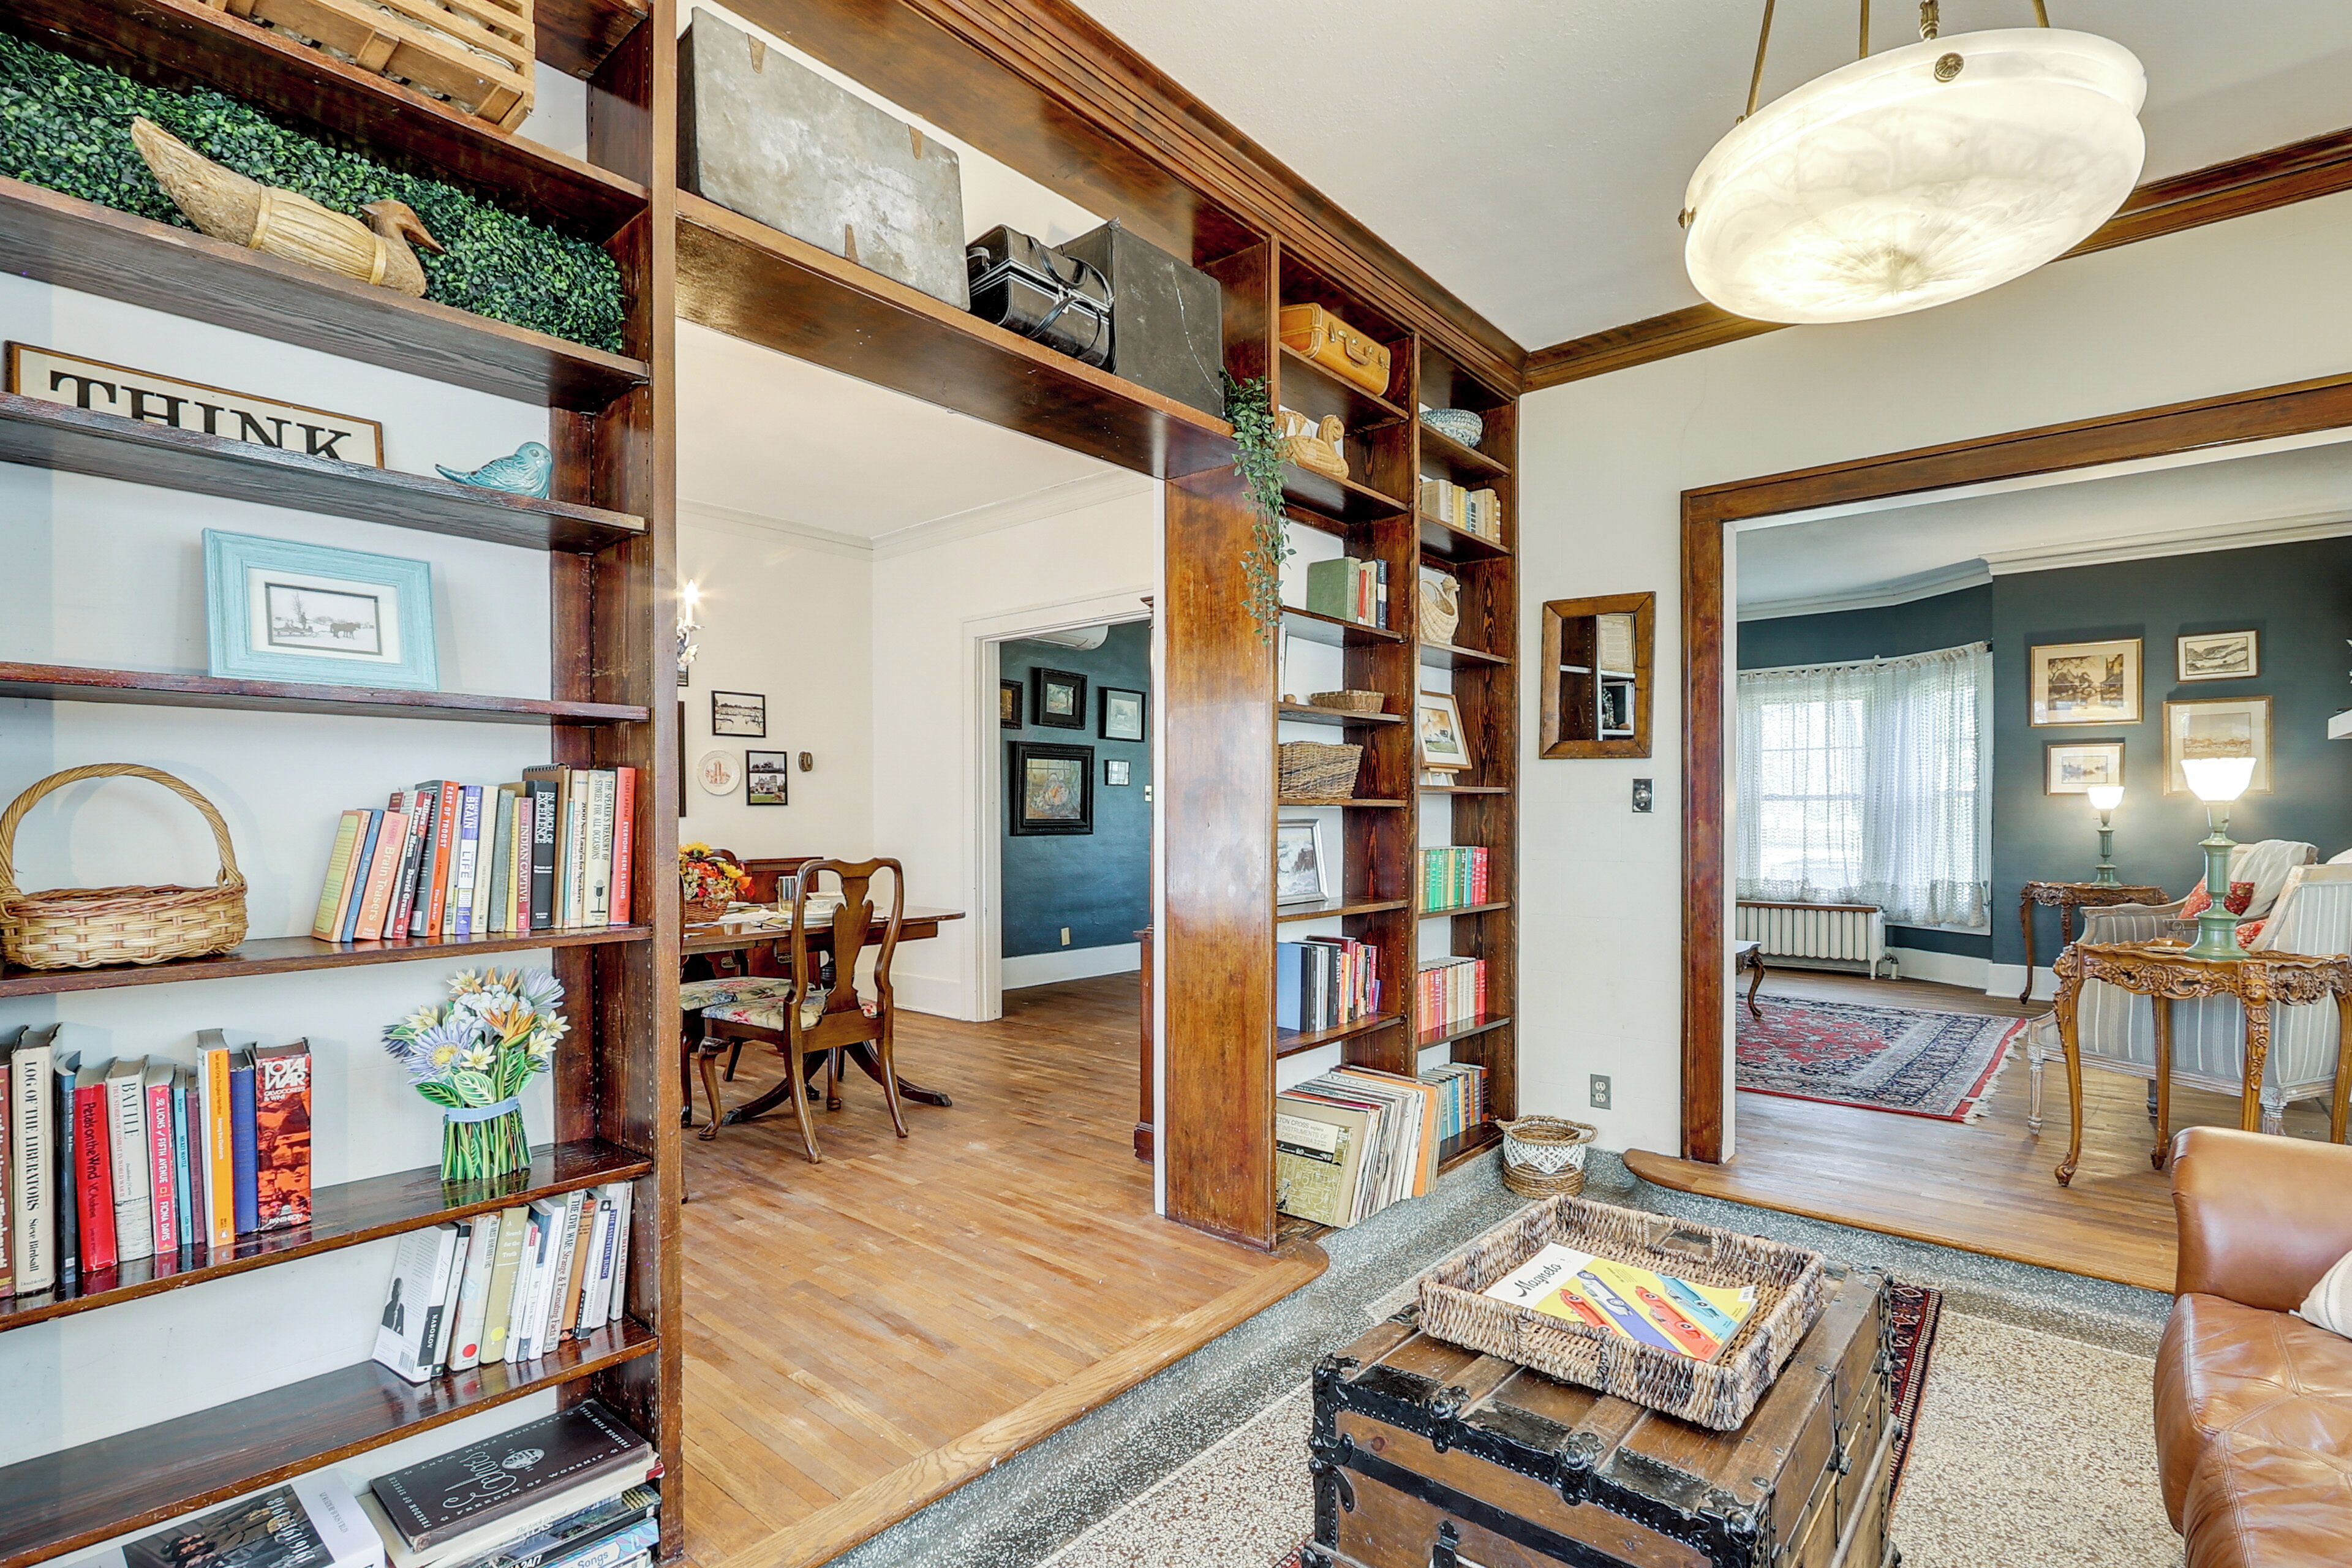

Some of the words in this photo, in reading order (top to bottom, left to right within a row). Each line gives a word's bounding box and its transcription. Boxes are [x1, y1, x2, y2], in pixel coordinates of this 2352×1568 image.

[50, 370, 352, 461] THINK
[445, 786, 454, 804] EAST
[594, 780, 603, 802] STORIES
[411, 807, 421, 835] Flower
[421, 799, 431, 826] Killers
[443, 807, 451, 817] OF
[464, 796, 475, 829] BRAIN
[537, 791, 547, 843] EXCELLENCE
[440, 819, 450, 848] TROOST
[519, 825, 529, 859] INDIAN
[546, 834, 553, 844] OF
[407, 835, 417, 858] Moon
[380, 846, 394, 876] Brain
[461, 851, 470, 878] LIFE
[404, 869, 414, 892] David
[519, 861, 528, 902] CAPTIVE
[369, 880, 387, 921] Teasers
[398, 893, 410, 919] Grann
[24, 1061, 37, 1087] LOG
[263, 1058, 308, 1072] TOTAL
[265, 1072, 306, 1090] WAR
[24, 1090, 37, 1105] OF
[25, 1106, 37, 1133] THE
[82, 1102, 98, 1128] Petals
[113, 1099, 121, 1121] STORIES
[121, 1083, 139, 1140] BATTLE
[156, 1108, 165, 1129] LIONS
[1277, 1116, 1289, 1125] LTON
[1291, 1119, 1309, 1129] CROSS
[1282, 1124, 1318, 1139] INSTRUMENTS
[86, 1129, 97, 1141] on
[1280, 1131, 1313, 1144] ORCHESTRA
[86, 1142, 100, 1155] the
[158, 1138, 167, 1156] FIFTH
[26, 1136, 39, 1211] LIBERATORS
[86, 1154, 101, 1180] Wind
[159, 1158, 168, 1183] AVENUE
[160, 1201, 169, 1221] FIONA
[571, 1199, 580, 1212] THE
[29, 1218, 39, 1240] Steve
[270, 1214, 304, 1224] PANTHEON
[568, 1213, 578, 1233] CIVIL
[162, 1223, 171, 1241] DAVIS
[565, 1234, 576, 1252] WAR:
[604, 1226, 615, 1261] ESSENTIAL
[29, 1241, 39, 1272] Birdsall
[558, 1250, 572, 1275] Strange
[1517, 1262, 1562, 1298] Magneto
[550, 1283, 566, 1319] Fascinating
[427, 1314, 439, 1348] NABOKOV
[549, 1319, 557, 1337] Facts
[579, 1406, 592, 1418] FEAR
[506, 1416, 561, 1439] FREEDOM
[592, 1417, 607, 1431] FROM
[465, 1439, 497, 1453] FROM
[608, 1428, 631, 1449] FREEDOM
[419, 1453, 457, 1471] WANT
[388, 1476, 402, 1494] SPEECH
[442, 1451, 518, 1509] Echoes
[456, 1486, 521, 1516] FREEDOM
[526, 1478, 542, 1488] OF
[548, 1453, 605, 1479] WORSHIP
[404, 1496, 412, 1507] OF
[412, 1507, 432, 1529] FREEDOM
[578, 1551, 609, 1568] Songs
